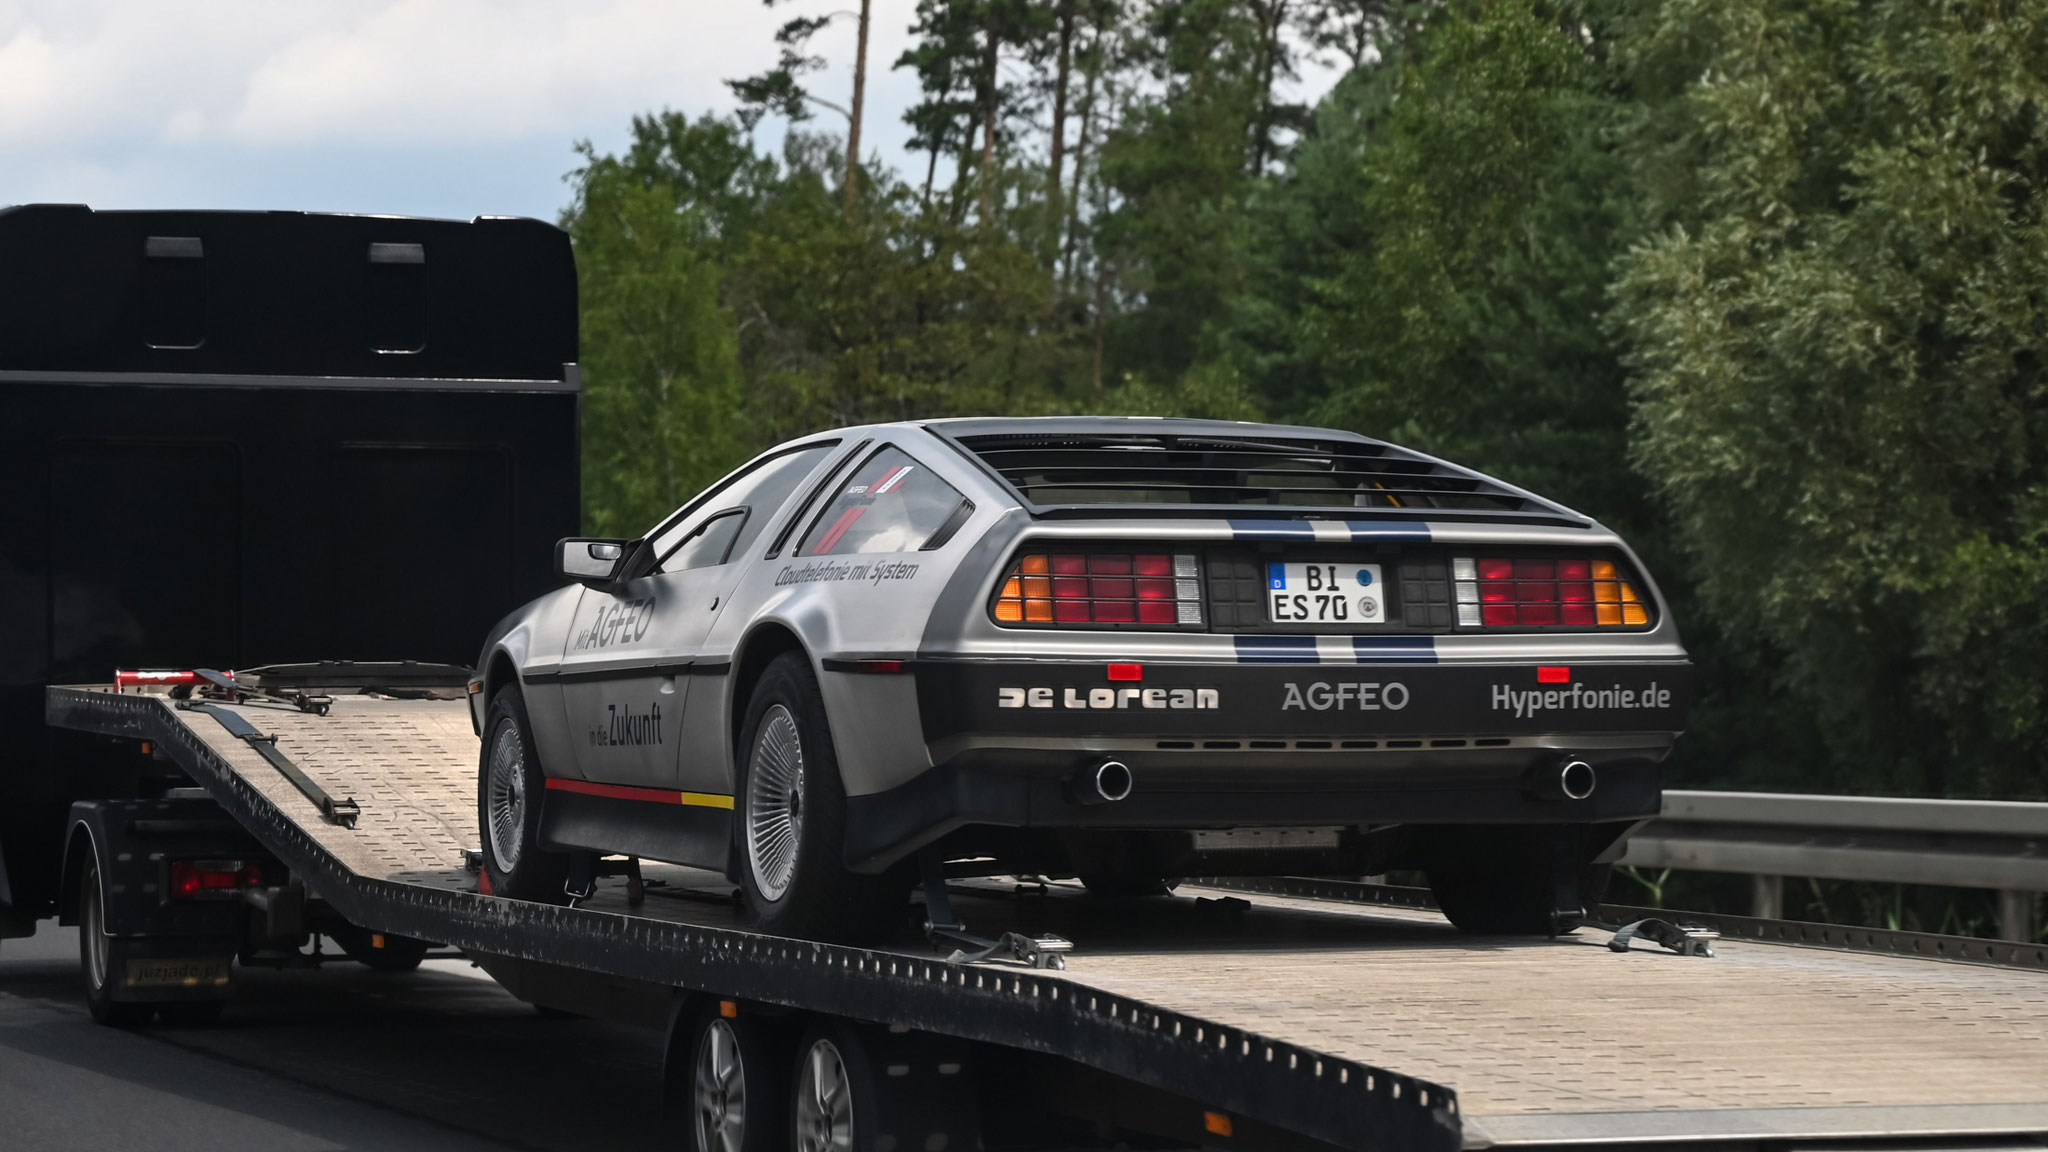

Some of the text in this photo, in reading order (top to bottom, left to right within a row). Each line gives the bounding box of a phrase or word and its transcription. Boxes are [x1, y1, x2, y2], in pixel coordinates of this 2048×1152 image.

[775, 560, 919, 587] Cloudtelefonie mit System
[1306, 565, 1340, 591] BI
[1274, 594, 1348, 620] ES 70
[585, 596, 656, 650] AGFEO
[1281, 681, 1410, 711] AGFEO
[1492, 681, 1671, 719] Hyperfonie.de
[608, 701, 662, 746] Zukunft
